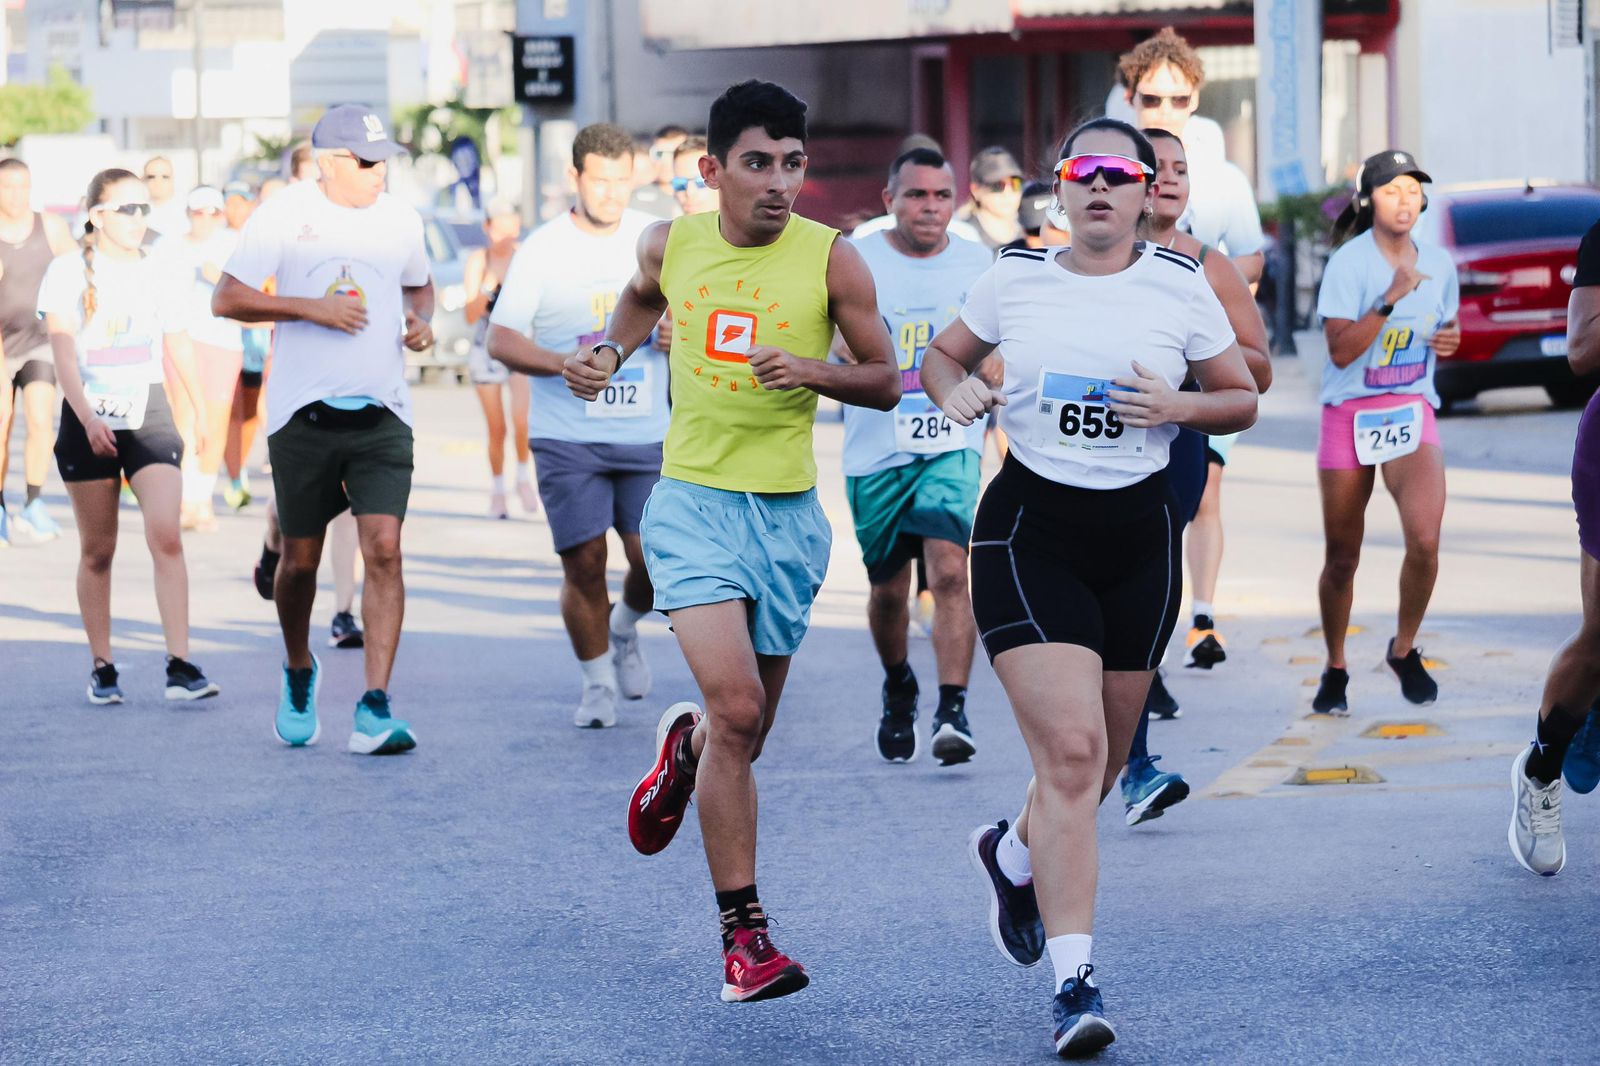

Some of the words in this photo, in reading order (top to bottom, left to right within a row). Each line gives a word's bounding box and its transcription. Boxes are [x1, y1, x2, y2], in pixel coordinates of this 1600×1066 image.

[736, 279, 790, 330] FLEX
[604, 385, 637, 405] 012
[910, 416, 951, 439] 284
[1059, 403, 1125, 440] 659
[1369, 425, 1411, 451] 245
